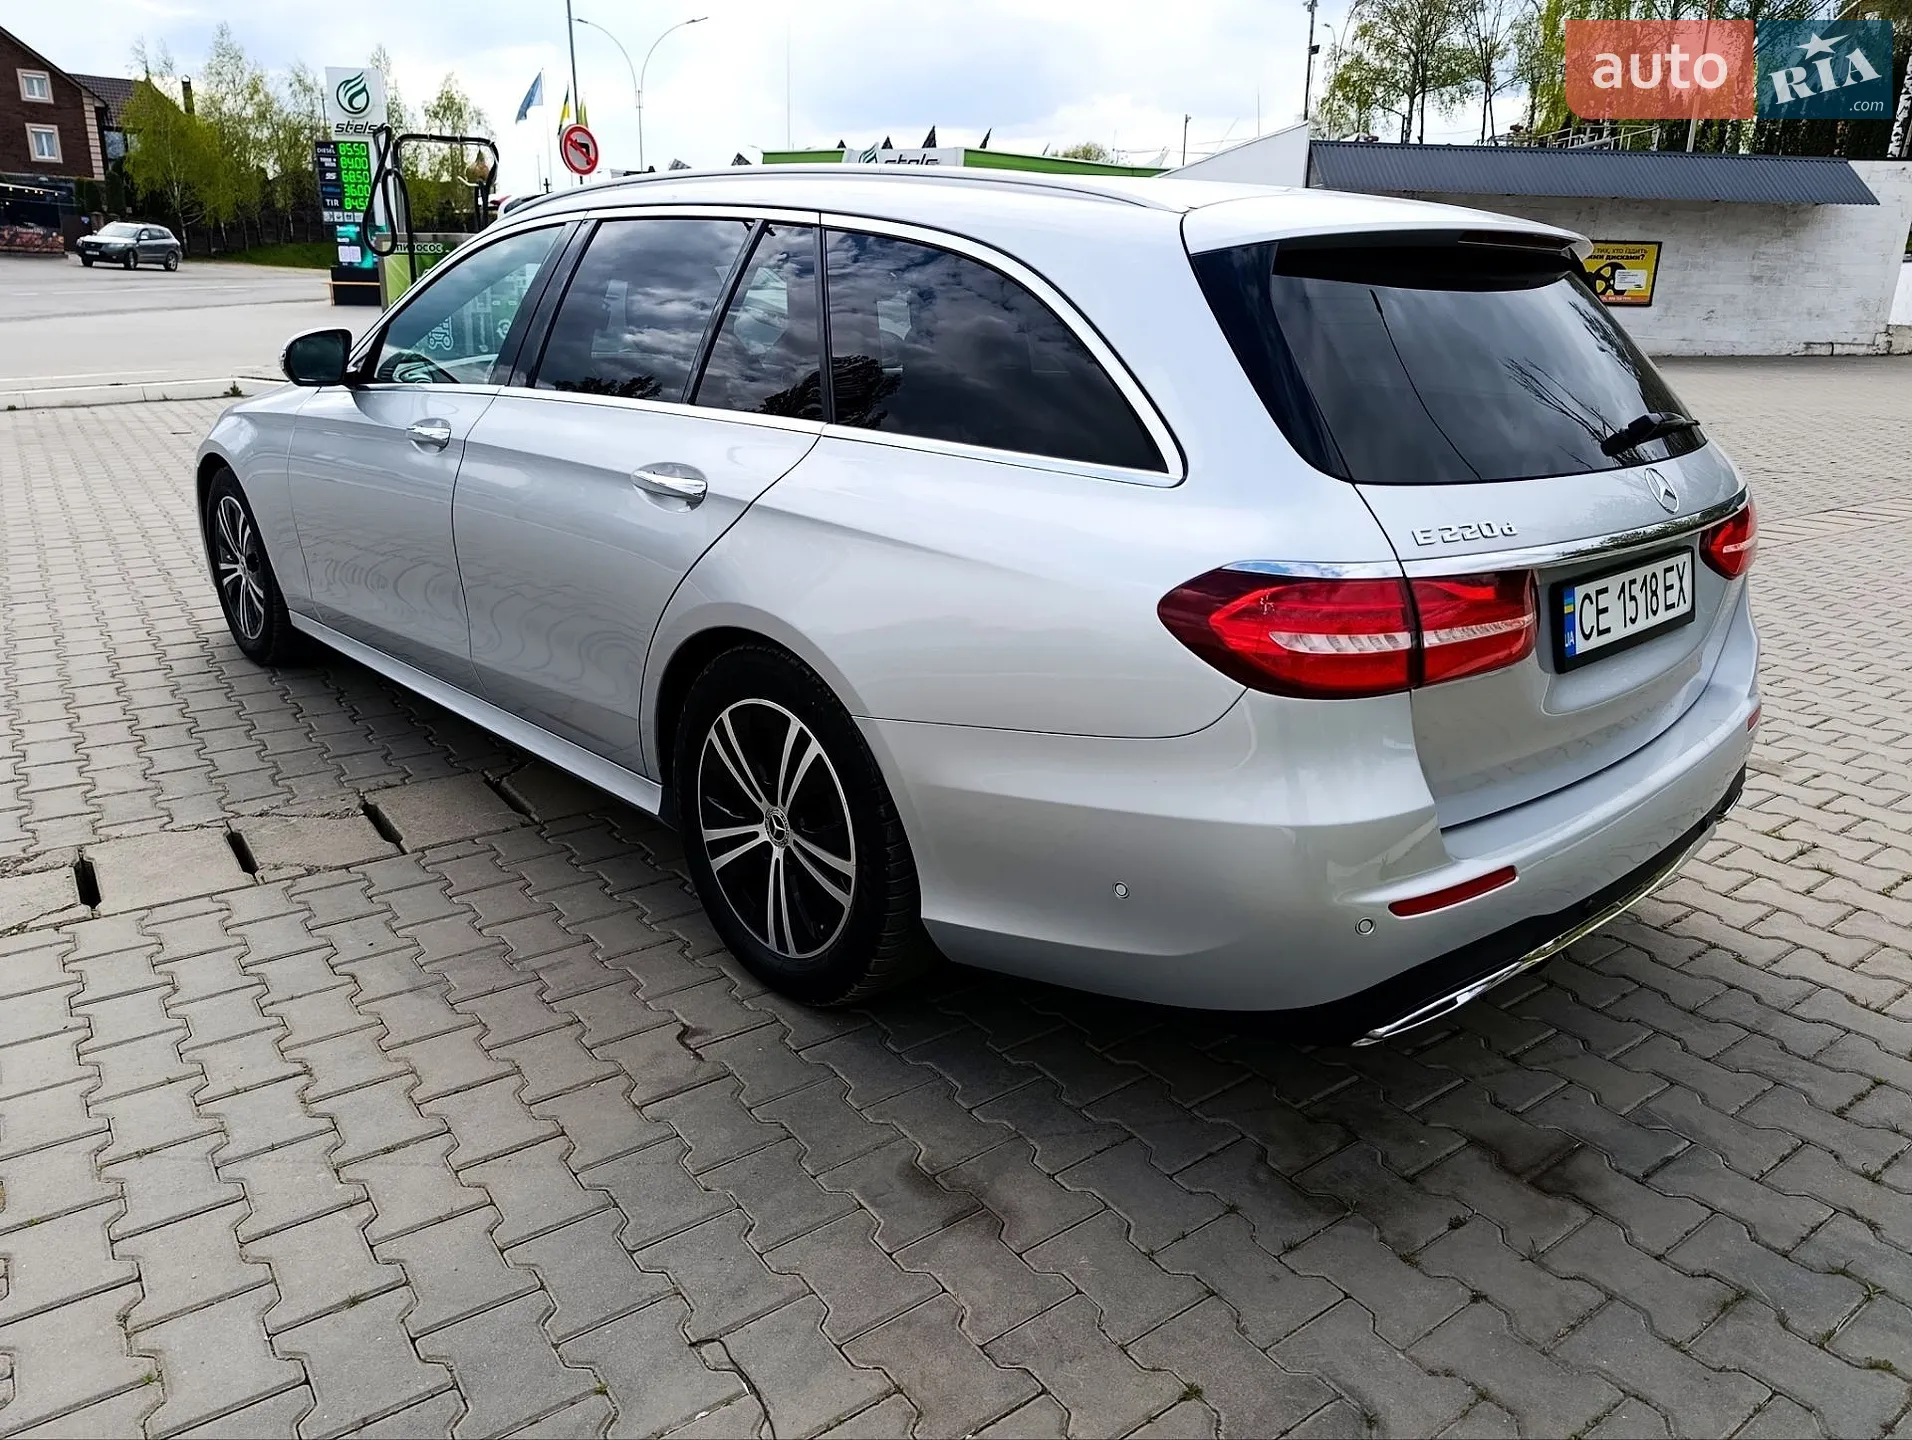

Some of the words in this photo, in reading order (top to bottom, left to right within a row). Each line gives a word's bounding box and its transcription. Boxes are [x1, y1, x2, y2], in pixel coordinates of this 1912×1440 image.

[325, 198, 340, 207] TIR
[1411, 528, 1437, 547] E
[1579, 586, 1612, 641] CE
[1617, 571, 1660, 629] 1518
[1663, 561, 1687, 612] EX
[1564, 630, 1575, 648] UA
